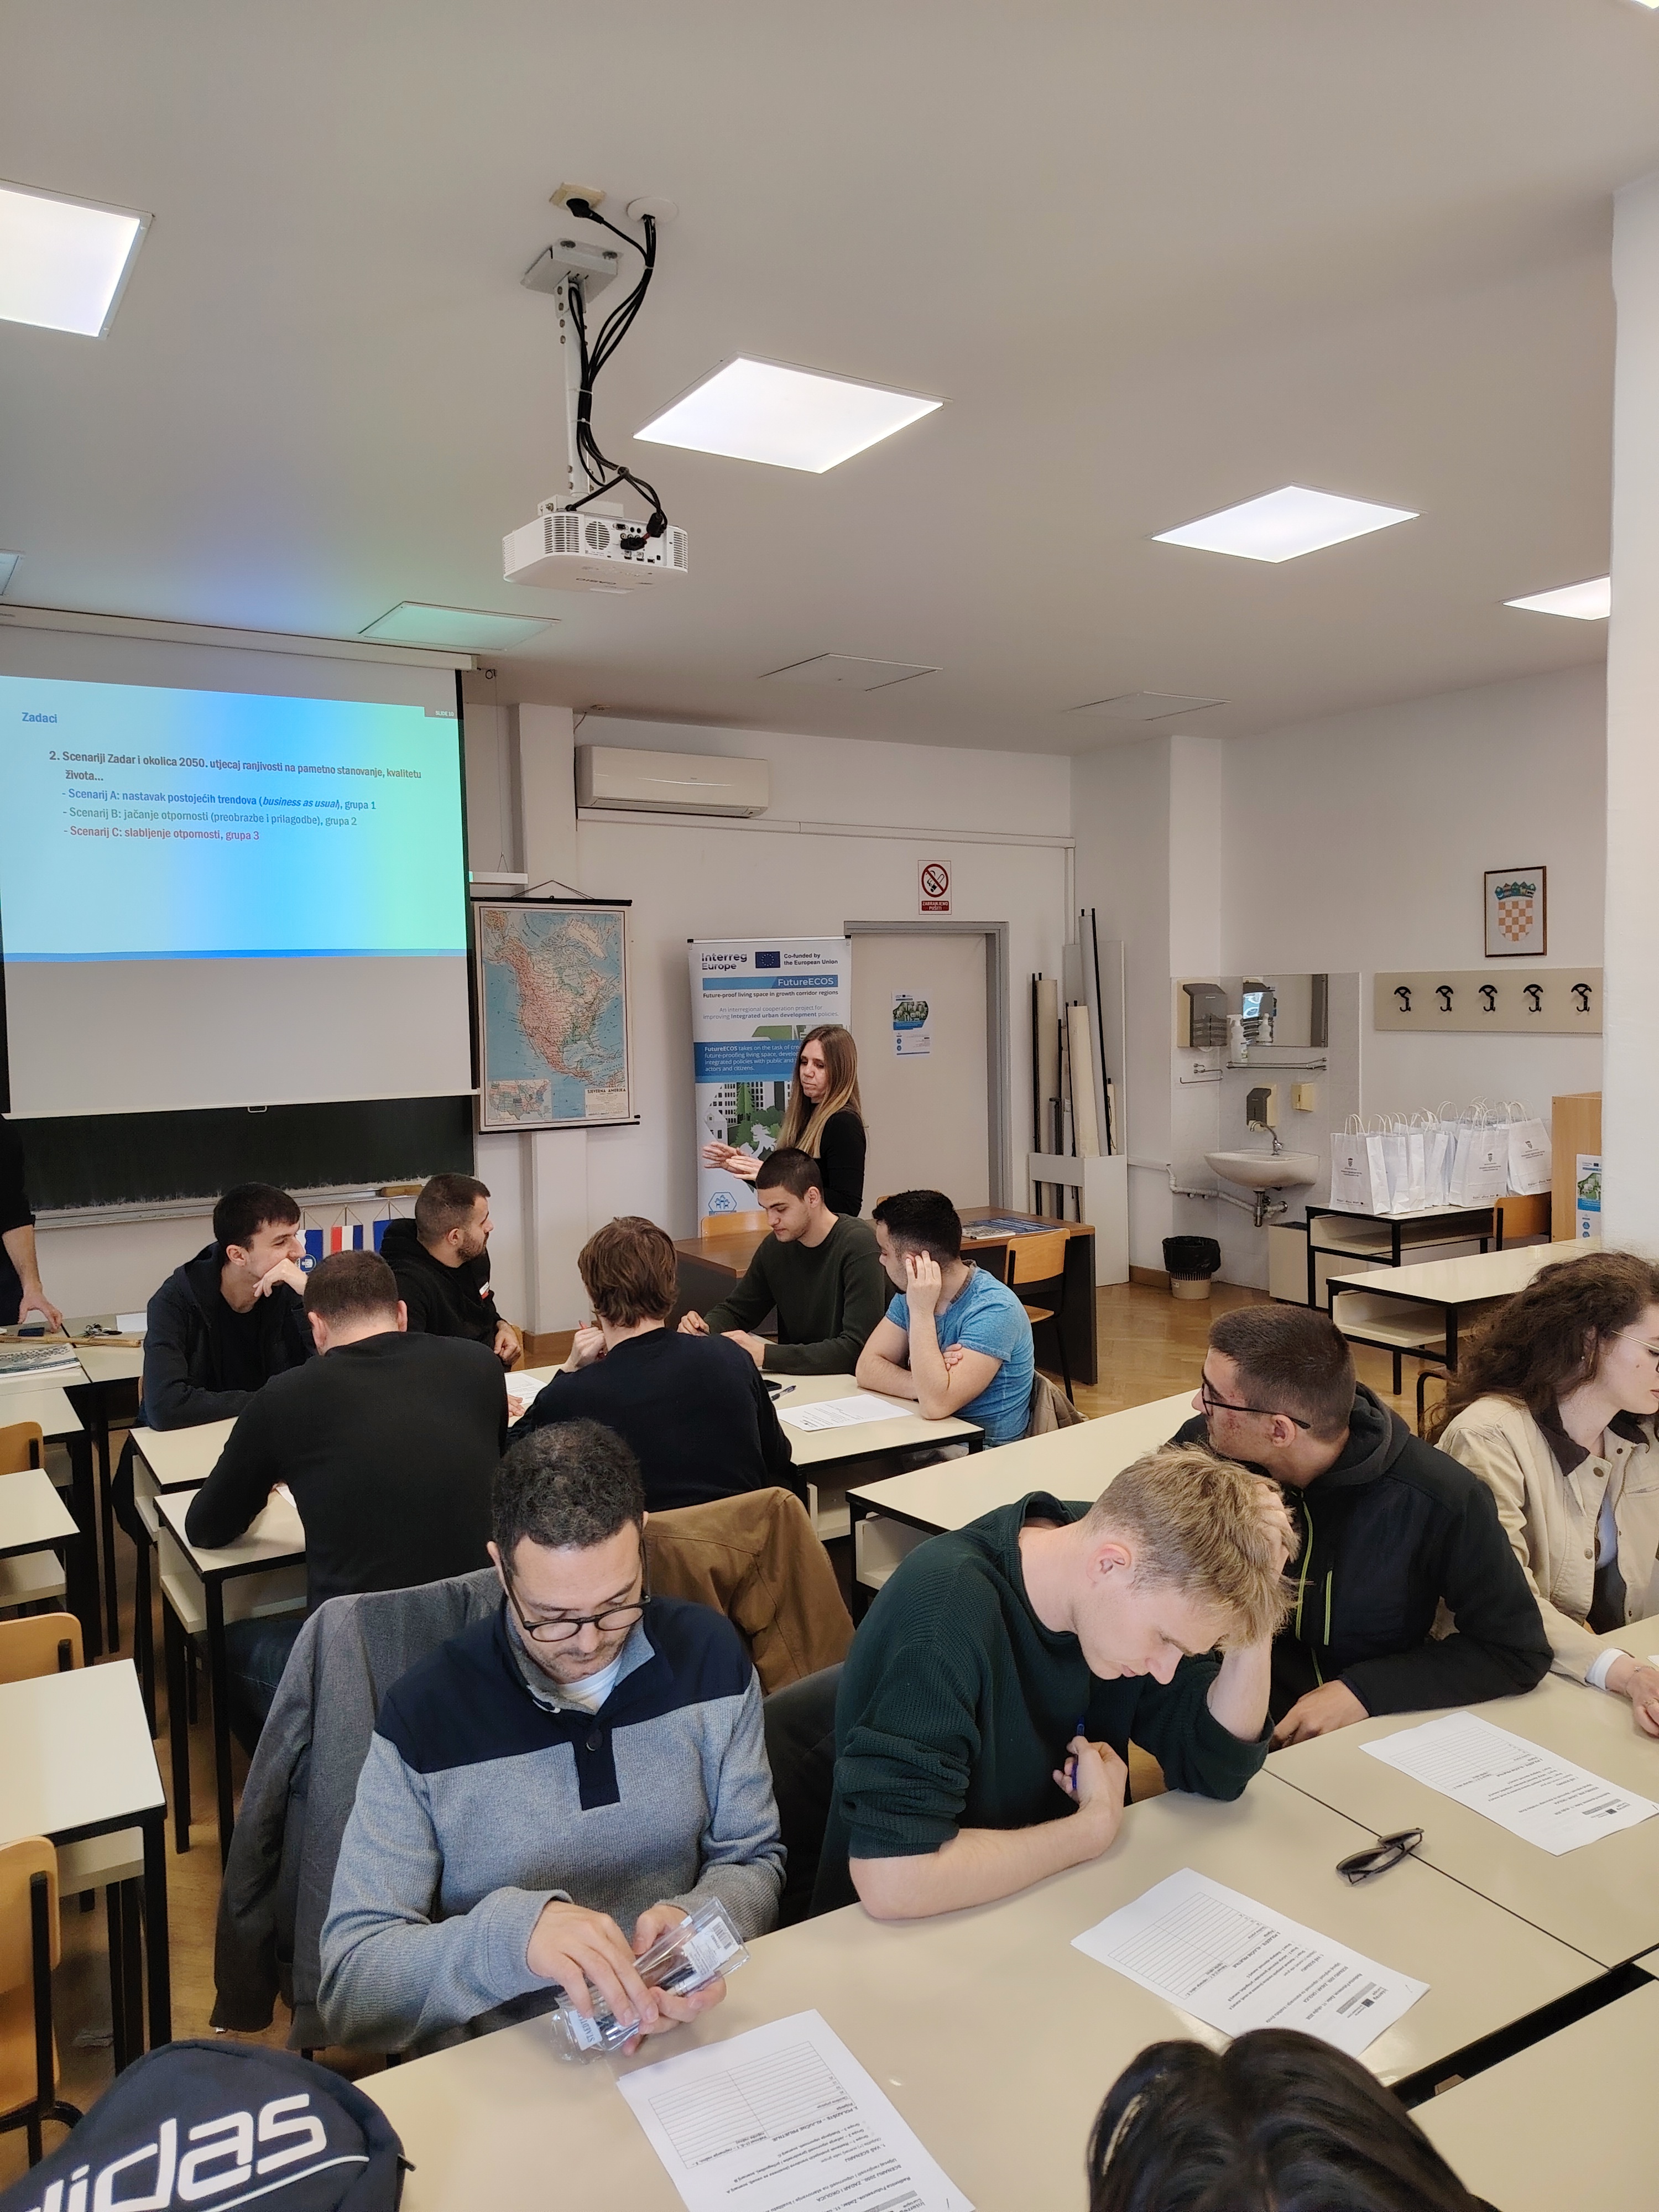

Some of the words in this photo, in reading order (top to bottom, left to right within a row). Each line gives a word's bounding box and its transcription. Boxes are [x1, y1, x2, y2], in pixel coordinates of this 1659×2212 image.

[22, 712, 58, 723] Zadaci
[49, 750, 60, 760] 2.
[62, 751, 105, 764] Scenariji
[107, 754, 136, 765] Zadar
[137, 755, 140, 765] i
[143, 755, 178, 766] okolica
[179, 757, 208, 768] 2050.
[210, 758, 241, 771] utjecaj
[242, 761, 283, 773] ranjivosti
[298, 765, 335, 775] pametno
[337, 766, 385, 778] stanovanje,
[387, 768, 421, 779] kvalitetu
[65, 769, 104, 781] života...
[69, 789, 108, 801] Scenarij
[110, 791, 120, 801] A:
[122, 792, 166, 802] nastavak
[168, 793, 216, 805] postojećih
[218, 794, 257, 805] trendova
[259, 795, 301, 807] (business
[315, 799, 343, 810] usual),
[345, 801, 369, 811] grupa
[371, 801, 377, 810] 1
[69, 807, 108, 820] Scenarij
[111, 810, 121, 819] B:
[123, 808, 159, 821] jačanje
[161, 811, 209, 822] otpornosti
[211, 812, 264, 823] (preobrazbe
[266, 814, 269, 822] i
[271, 815, 324, 826] prilagodbe),
[325, 817, 349, 827] grupa
[351, 817, 357, 826] 2
[70, 826, 109, 838] Scenarij
[112, 828, 122, 837] C:
[124, 828, 171, 839] slabljenje
[173, 830, 223, 841] otpornosti,
[226, 832, 251, 841] grupa
[253, 831, 259, 840] 3
[701, 953, 747, 962] Interreg
[778, 978, 834, 987] FutureECOS
[899, 2200, 925, 2212] Interre
